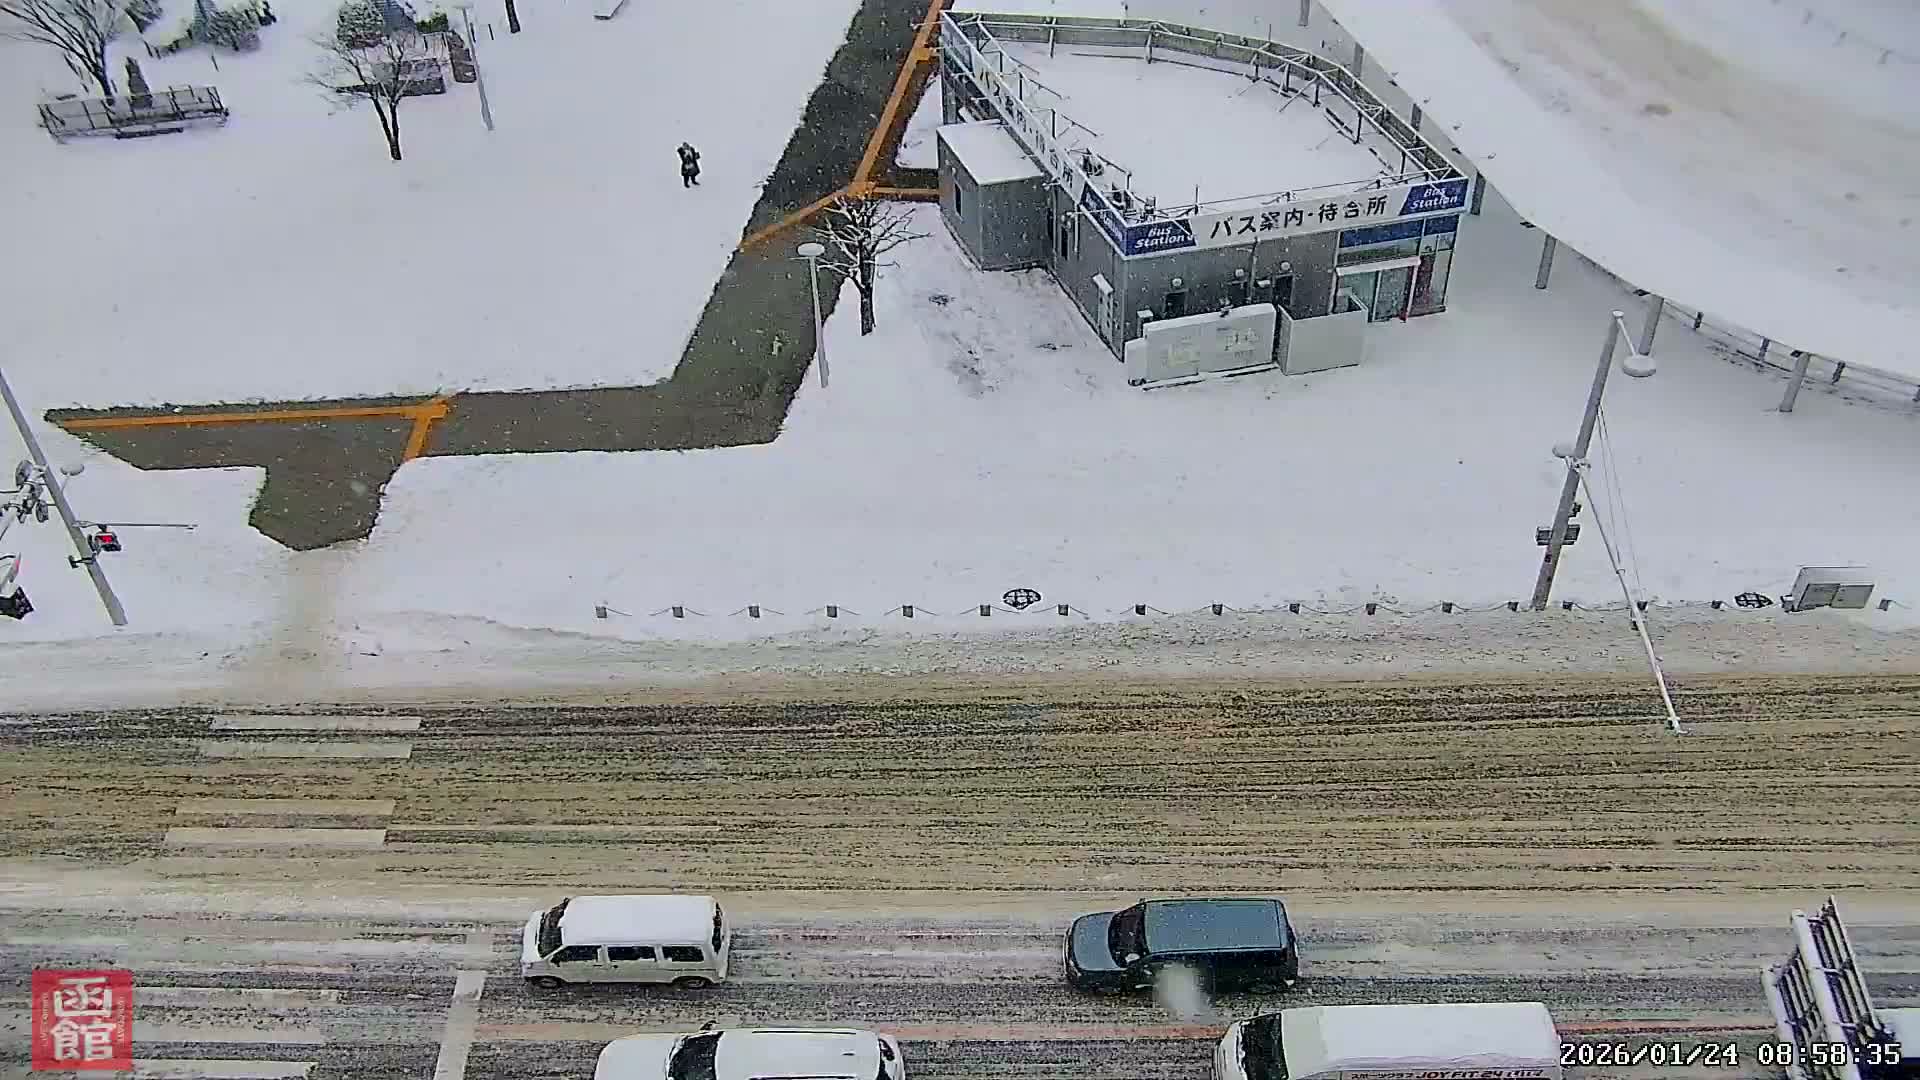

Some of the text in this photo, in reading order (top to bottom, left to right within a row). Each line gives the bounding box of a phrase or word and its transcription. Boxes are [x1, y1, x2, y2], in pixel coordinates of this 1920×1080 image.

[1210, 194, 1388, 239] バス案内・待合所
[1147, 226, 1171, 238] Bus
